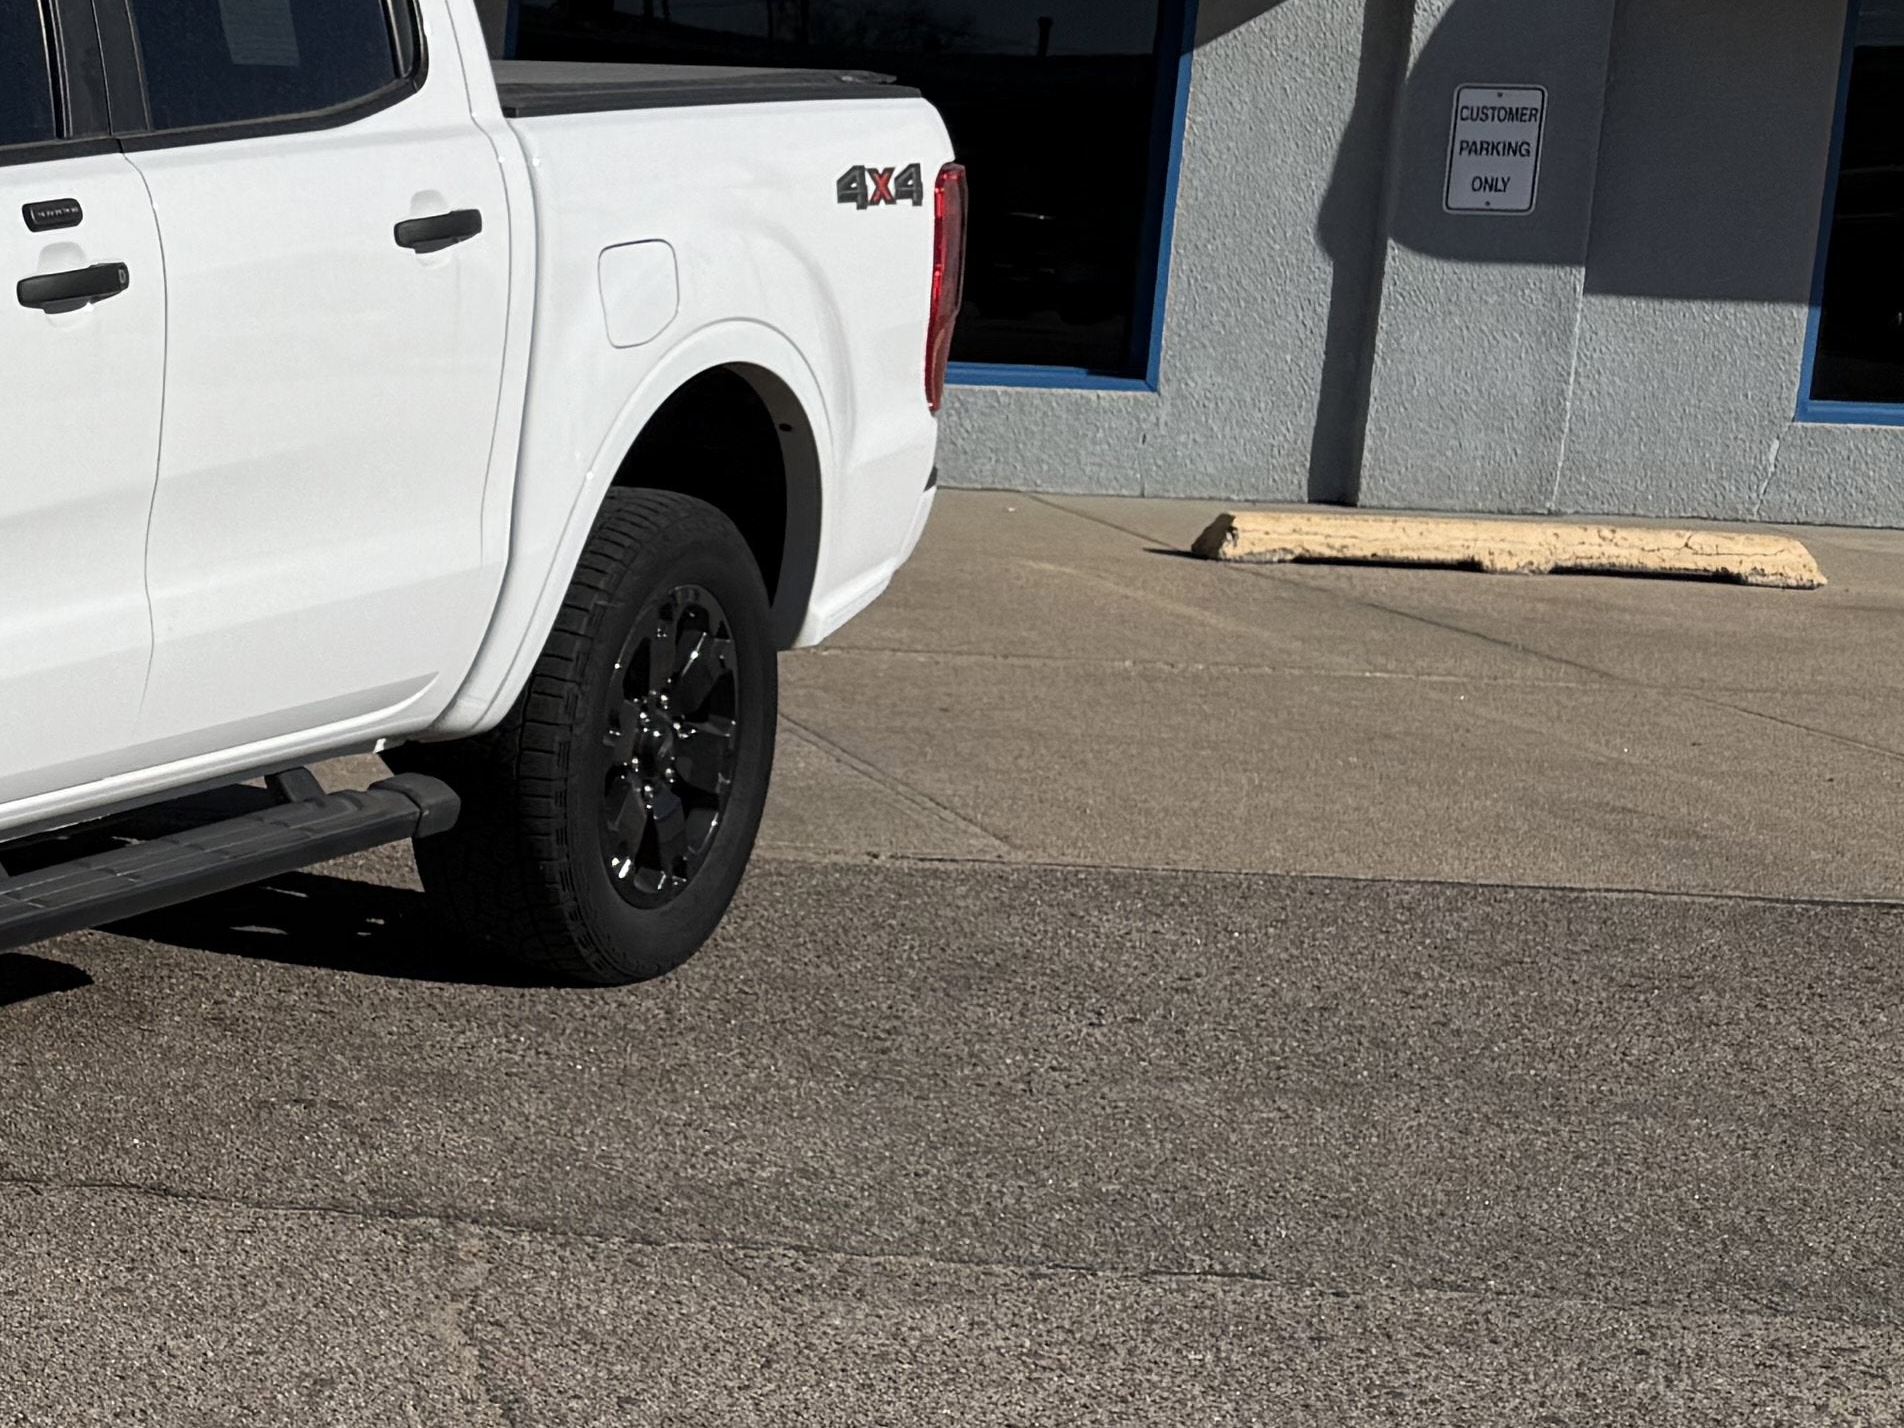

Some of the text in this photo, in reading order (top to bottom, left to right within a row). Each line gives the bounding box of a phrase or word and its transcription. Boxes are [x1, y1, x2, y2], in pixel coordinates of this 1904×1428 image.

[1459, 105, 1538, 123] CUSTOMER
[1458, 140, 1531, 157] PARKING
[1471, 176, 1511, 193] ONLY
